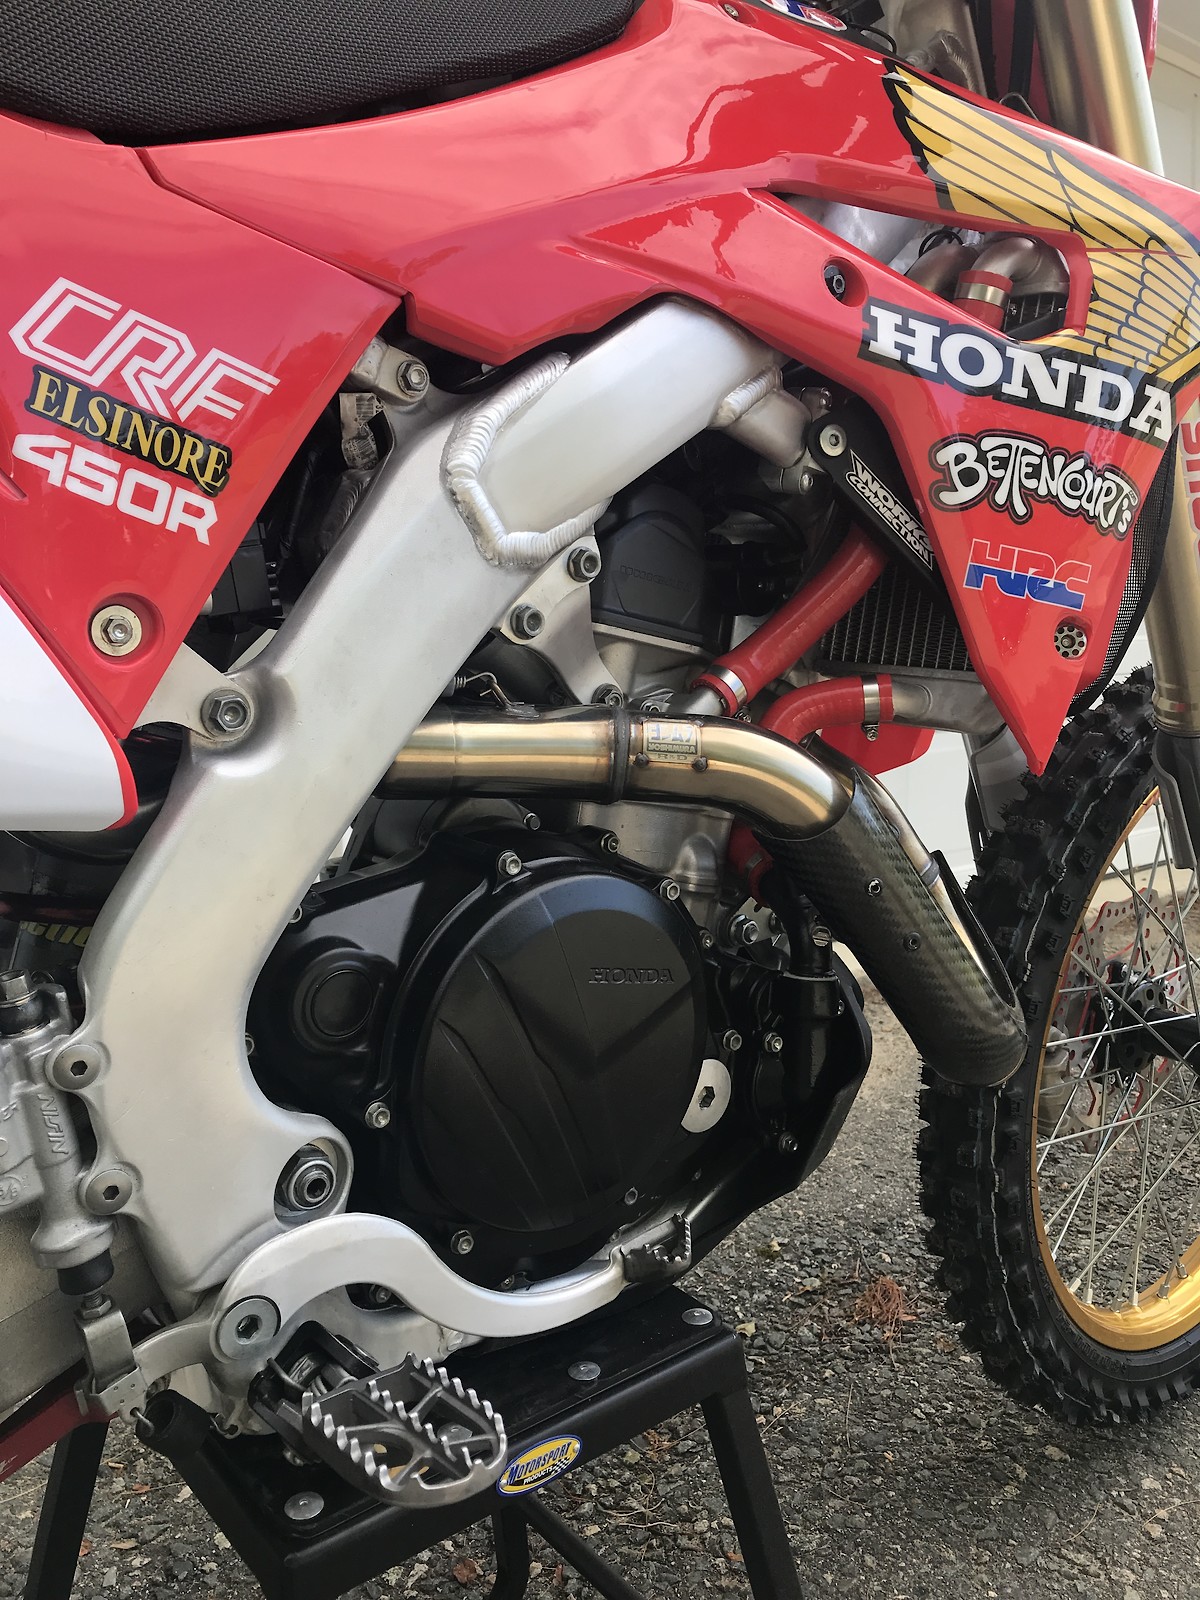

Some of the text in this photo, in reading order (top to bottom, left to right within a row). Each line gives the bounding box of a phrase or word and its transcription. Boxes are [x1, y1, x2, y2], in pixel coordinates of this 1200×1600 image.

[8, 277, 280, 422] CRF
[868, 306, 1174, 442] HONDA
[30, 370, 229, 493] ELSINORE
[12, 433, 218, 545] 450R
[849, 475, 929, 562] CONNECTION
[855, 459, 934, 553] WORKS
[935, 436, 1138, 533] BETTENCOURT'S
[963, 538, 1092, 611] HRC
[648, 743, 696, 754] YOSHIMURA
[588, 967, 675, 984] HONDA
[506, 1441, 572, 1486] MOTORSPORT
[523, 1466, 553, 1485] PRODUCTS
